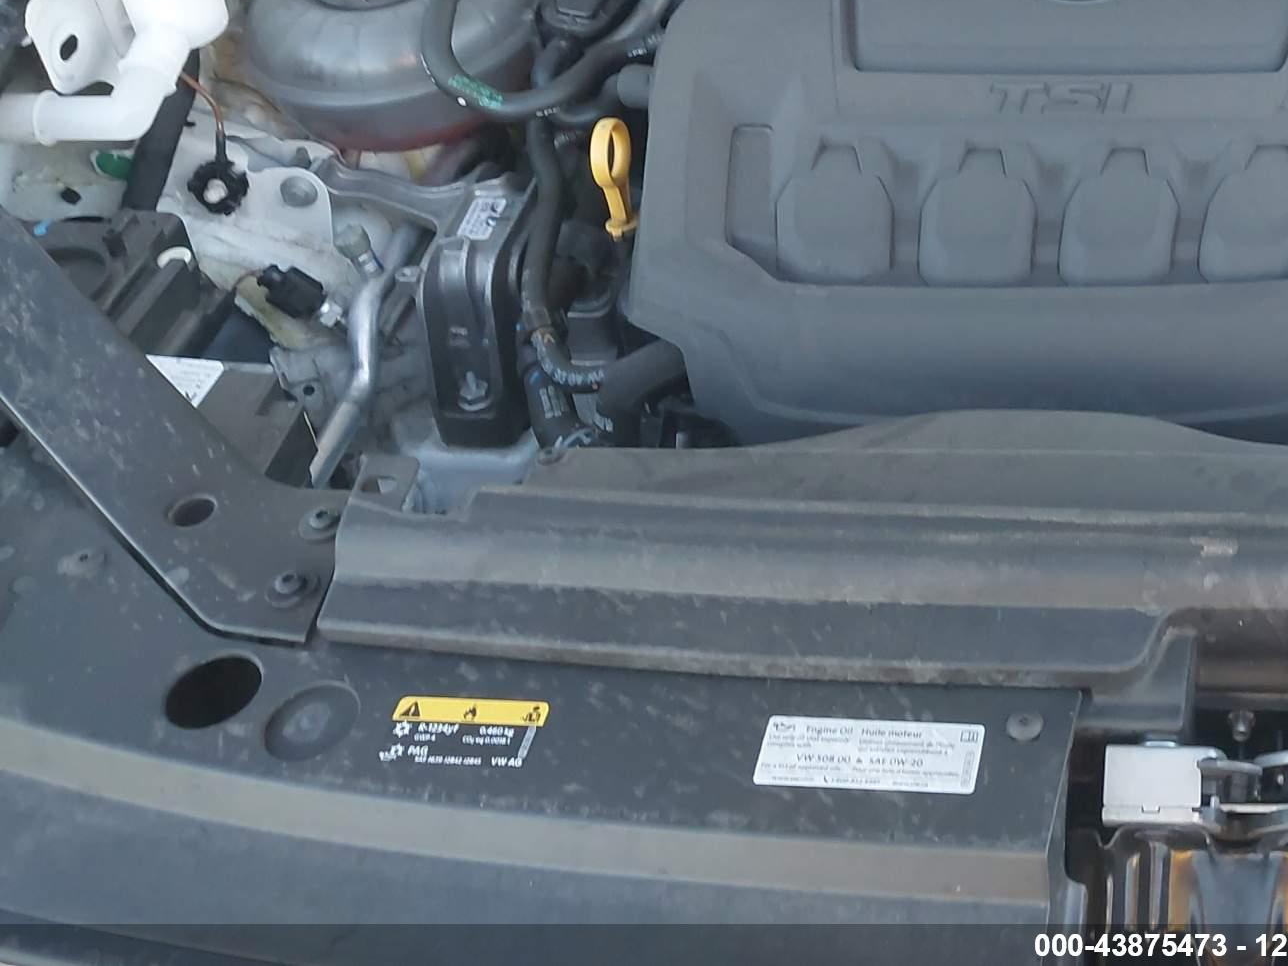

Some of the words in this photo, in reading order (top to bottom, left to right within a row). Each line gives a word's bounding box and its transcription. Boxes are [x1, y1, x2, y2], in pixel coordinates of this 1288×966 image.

[990, 82, 1134, 115] TSI
[806, 725, 838, 736] Engine
[839, 726, 854, 735] Oil
[861, 727, 888, 737] Huile
[889, 729, 923, 739] moteur
[490, 756, 507, 767] VW
[507, 757, 523, 768] AG
[796, 754, 814, 763] VW
[815, 755, 834, 763] 508
[836, 756, 852, 764] 00
[869, 758, 887, 766] SAE
